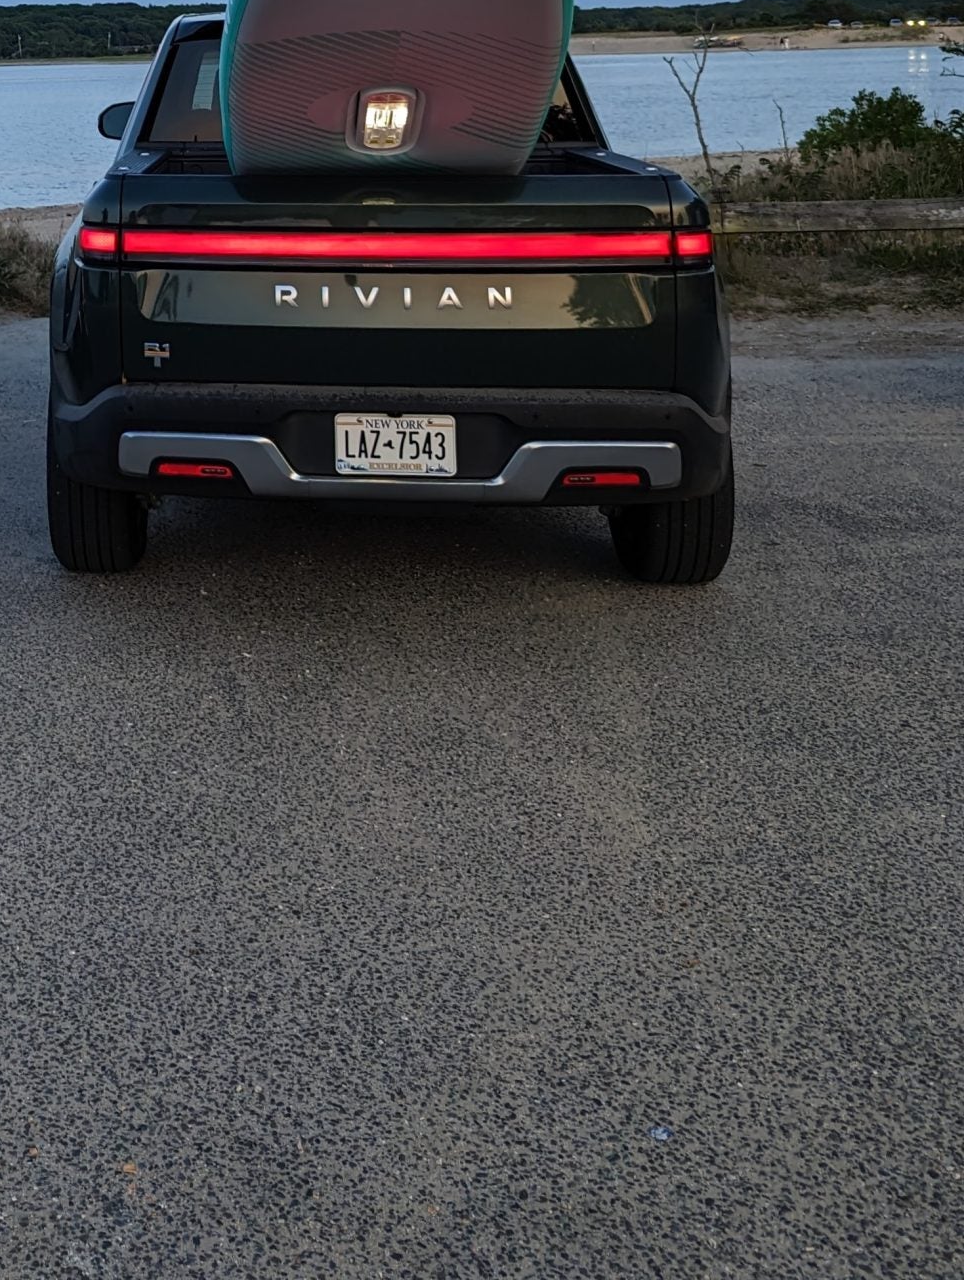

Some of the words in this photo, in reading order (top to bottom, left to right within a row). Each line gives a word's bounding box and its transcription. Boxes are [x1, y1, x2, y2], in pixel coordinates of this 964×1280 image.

[274, 285, 512, 309] RIVIAN
[365, 419, 391, 429] NEW
[394, 420, 425, 430] YORK
[369, 462, 423, 471] EXCELSIOR
